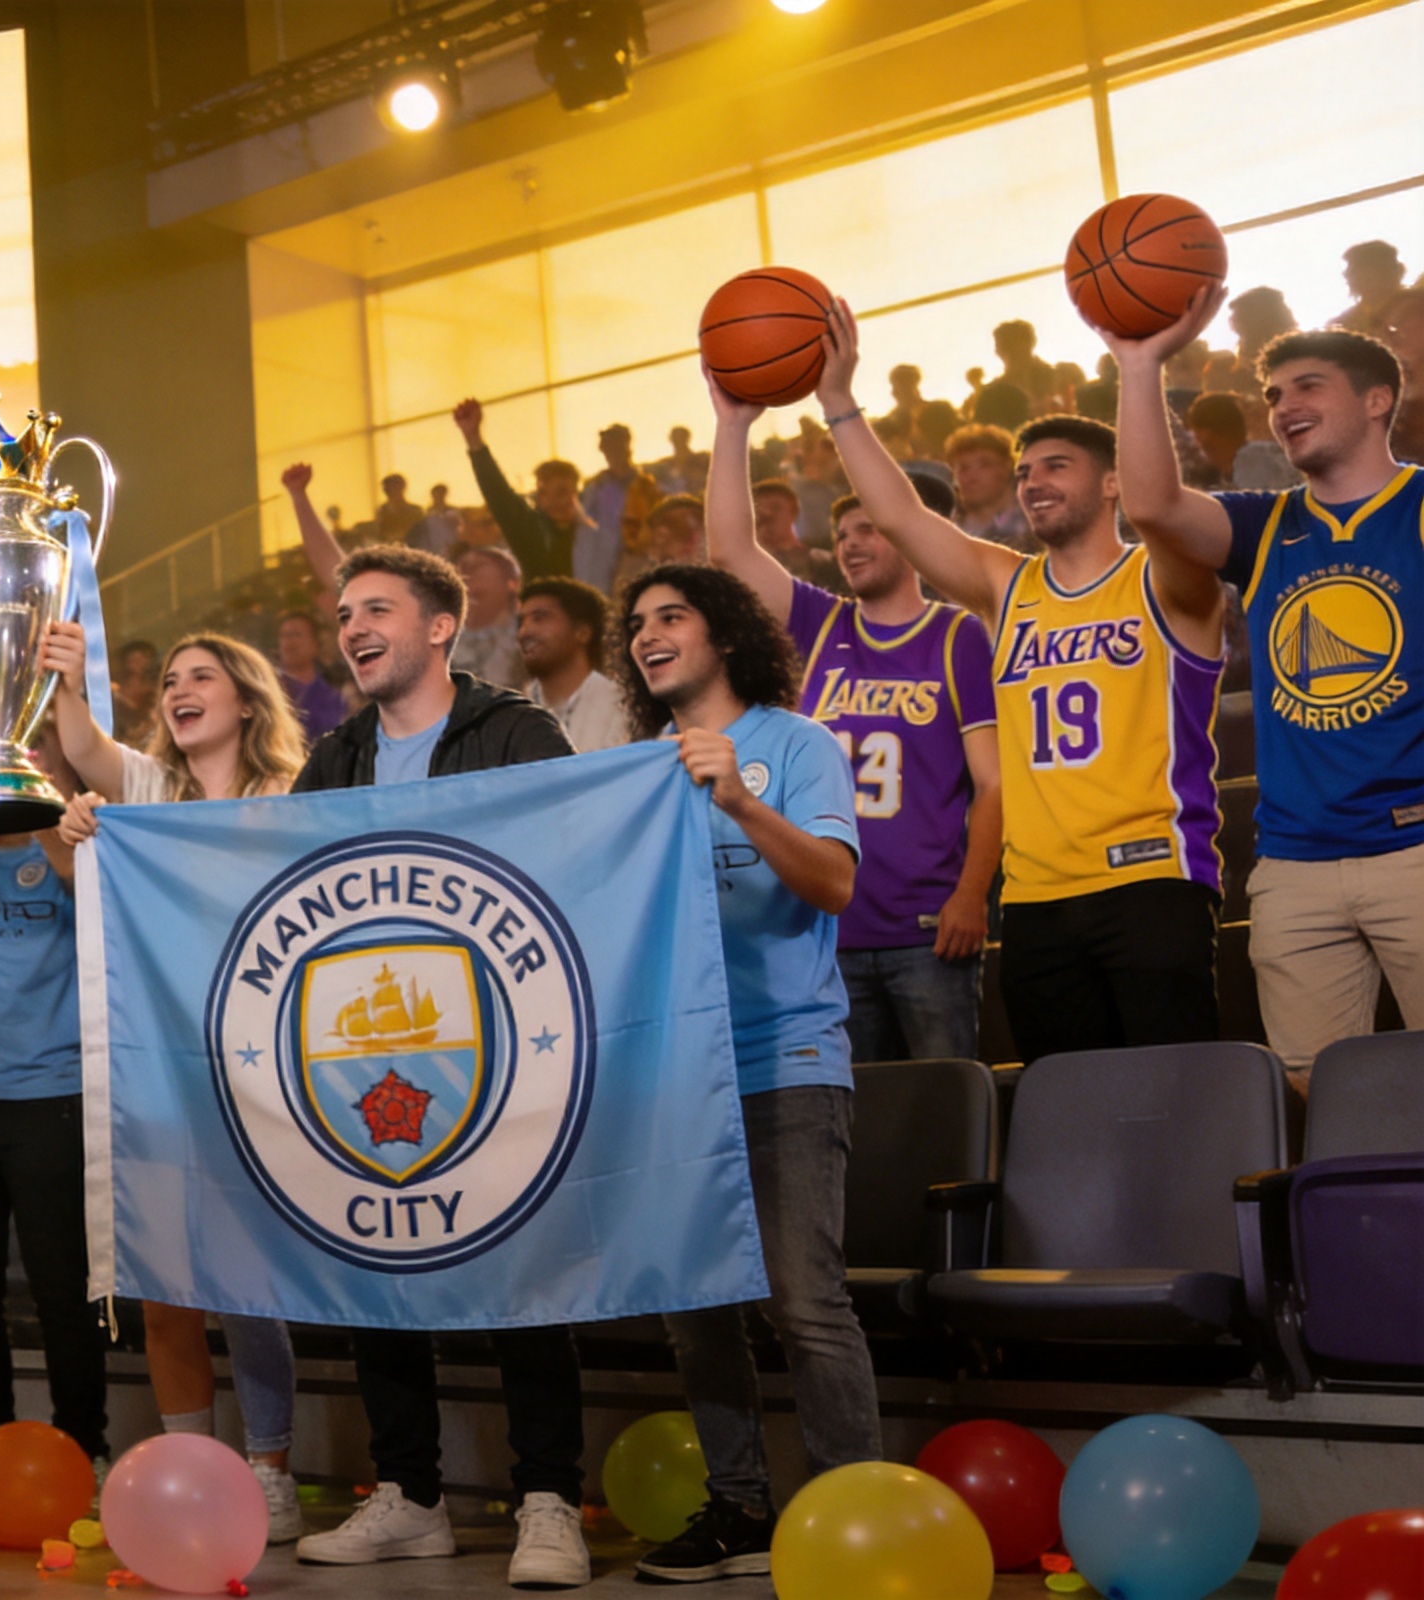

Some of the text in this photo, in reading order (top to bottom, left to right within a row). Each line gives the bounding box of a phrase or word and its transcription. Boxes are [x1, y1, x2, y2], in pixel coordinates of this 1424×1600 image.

[996, 616, 1146, 686] LAKERS
[811, 667, 942, 726] LAKERS
[1030, 679, 1102, 770] 19
[238, 865, 548, 996] MANCHESTER
[346, 1190, 465, 1239] CITY
